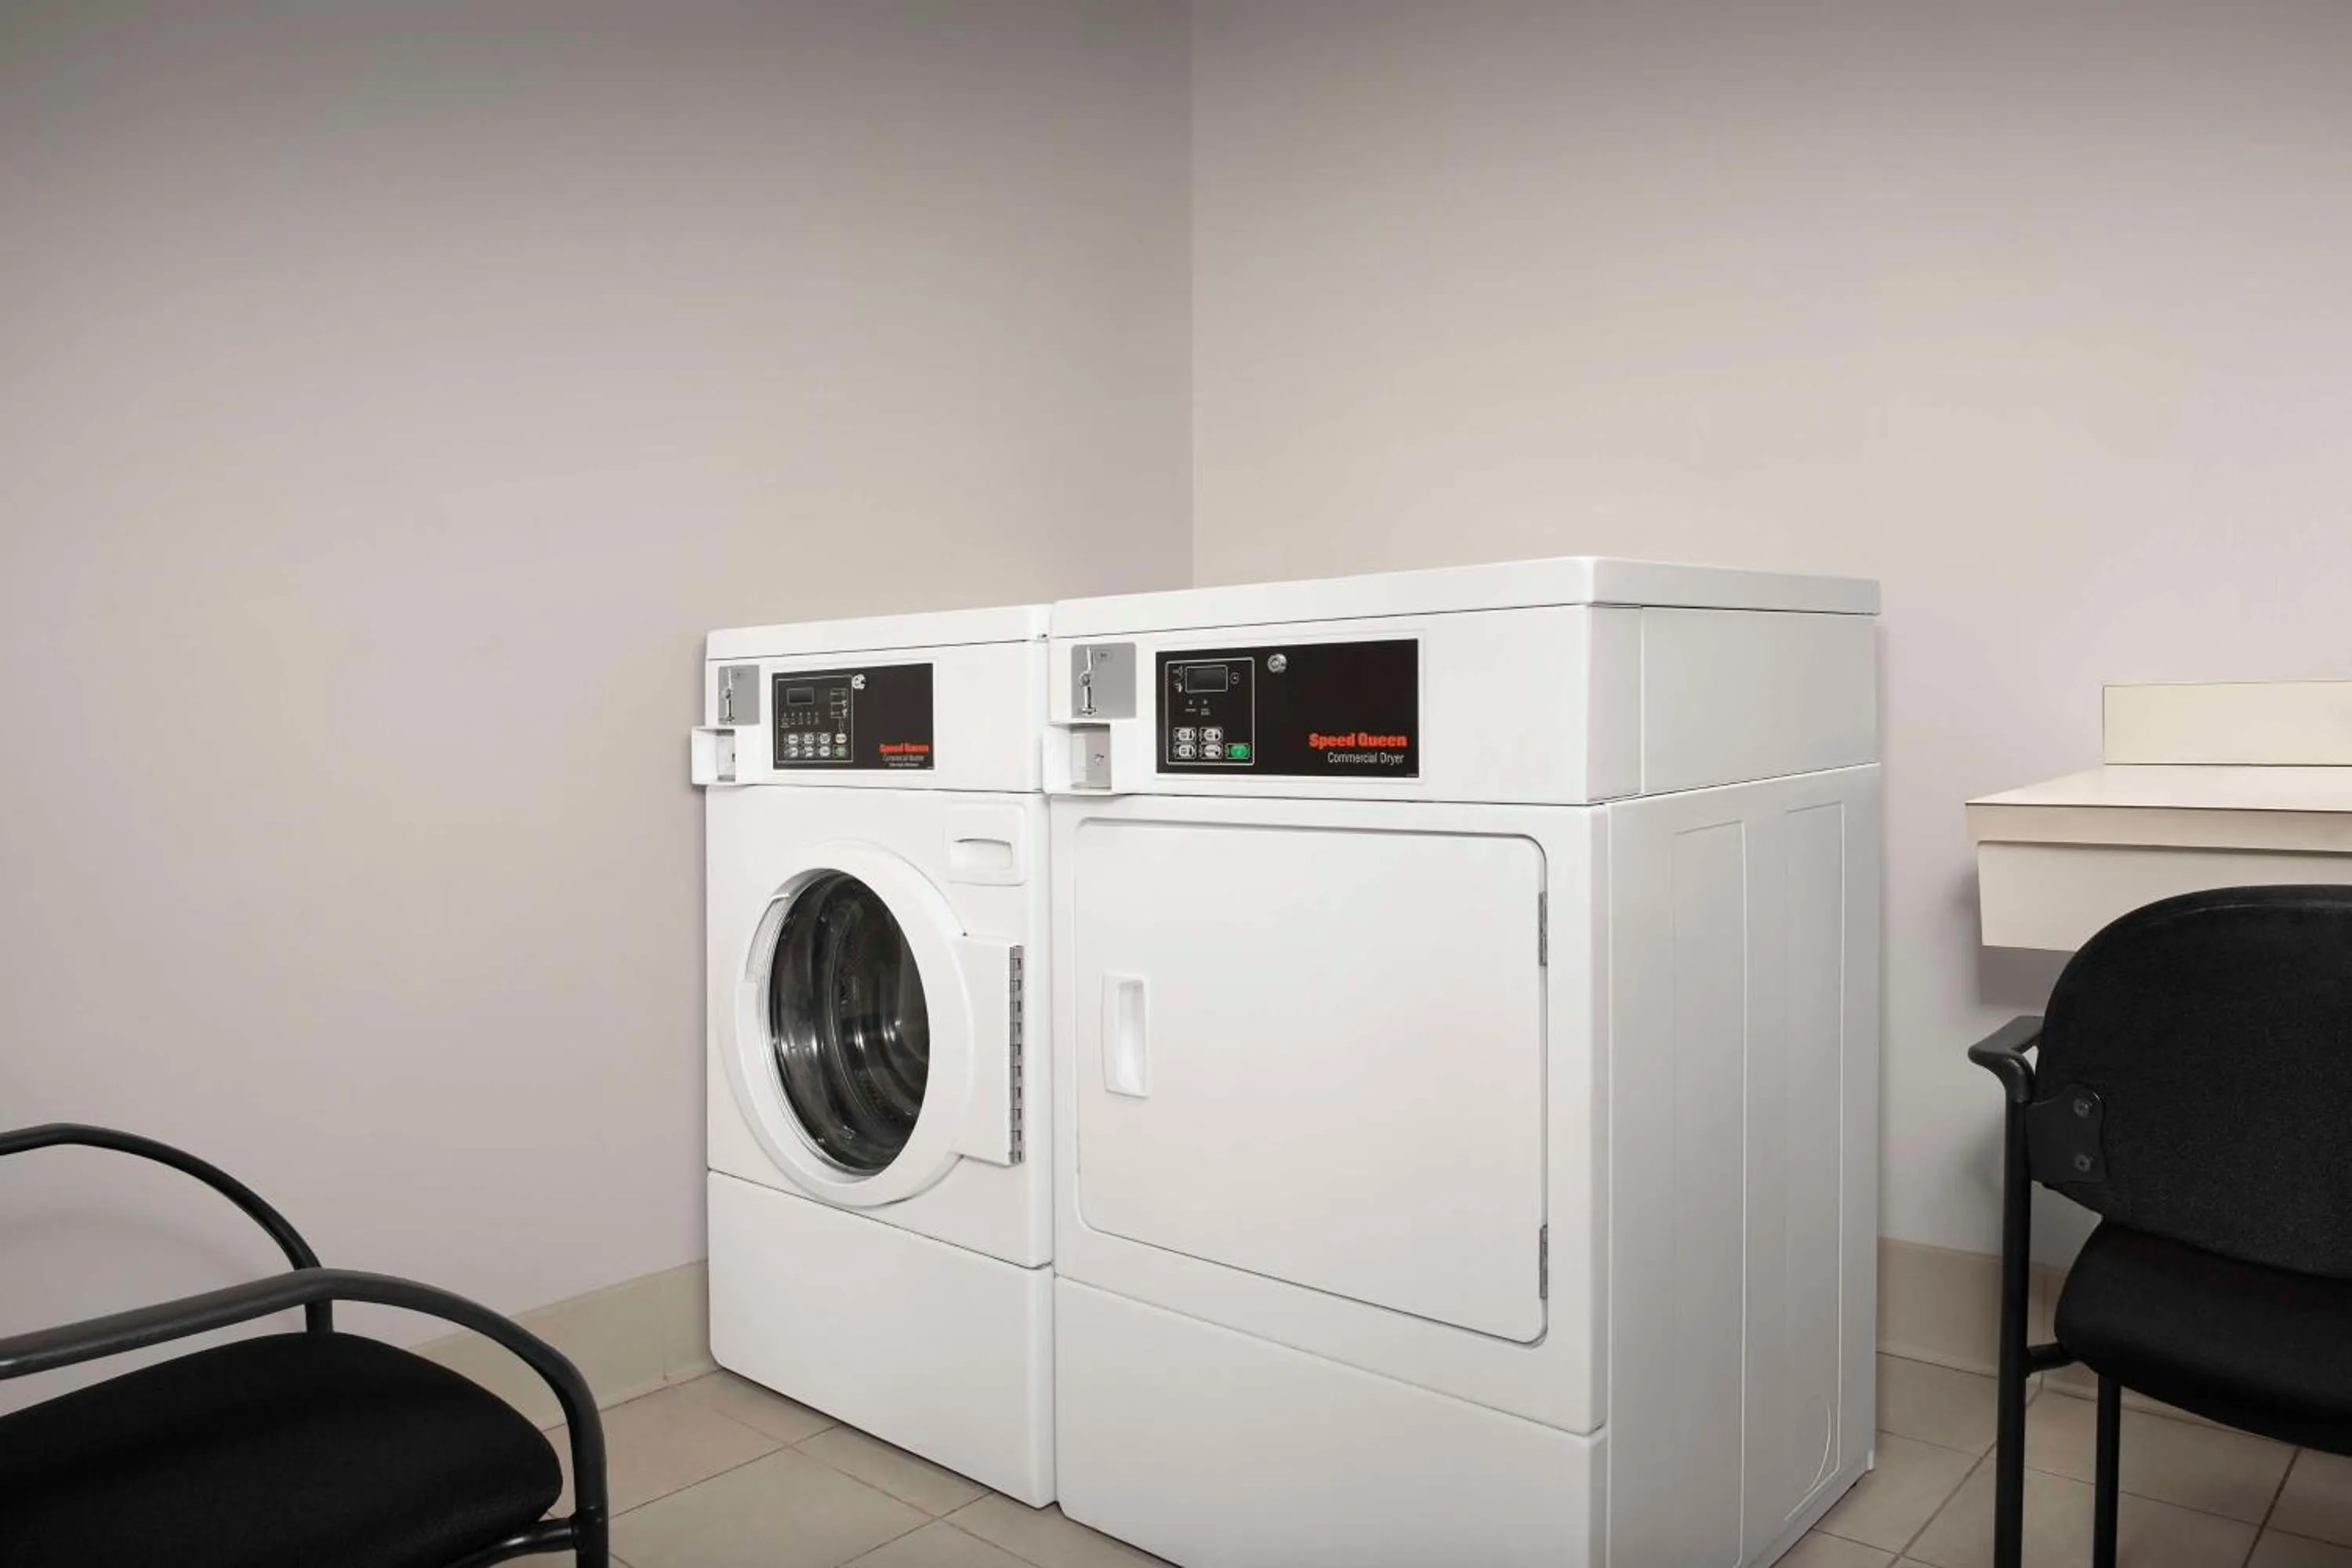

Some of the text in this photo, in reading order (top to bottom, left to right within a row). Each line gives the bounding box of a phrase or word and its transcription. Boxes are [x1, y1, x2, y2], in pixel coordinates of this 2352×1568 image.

[1308, 732, 1407, 750] Speed Queen
[1327, 752, 1404, 765] Commercial Dryer
